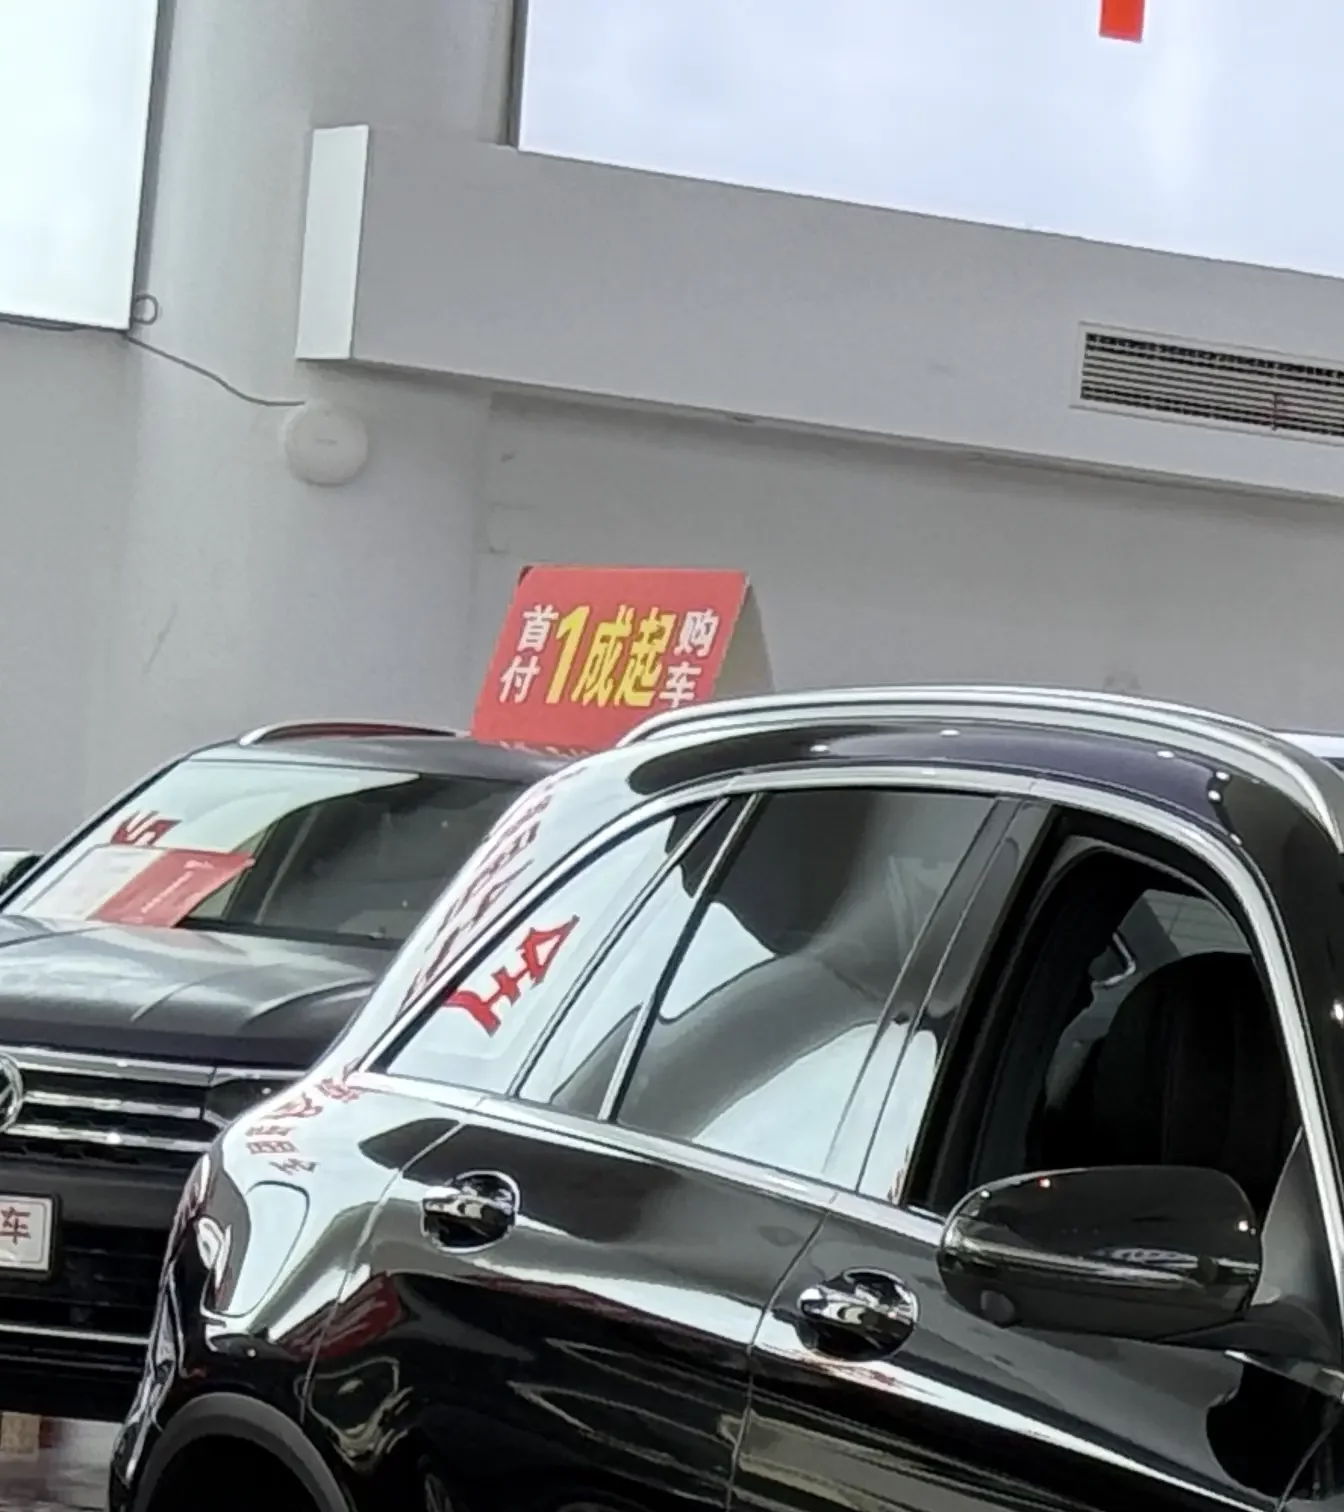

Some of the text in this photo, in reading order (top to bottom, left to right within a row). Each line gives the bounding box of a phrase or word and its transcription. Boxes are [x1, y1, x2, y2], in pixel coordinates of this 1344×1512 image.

[499, 604, 559, 704] 首付
[545, 604, 677, 708] 1成起
[658, 608, 720, 708] 购车
